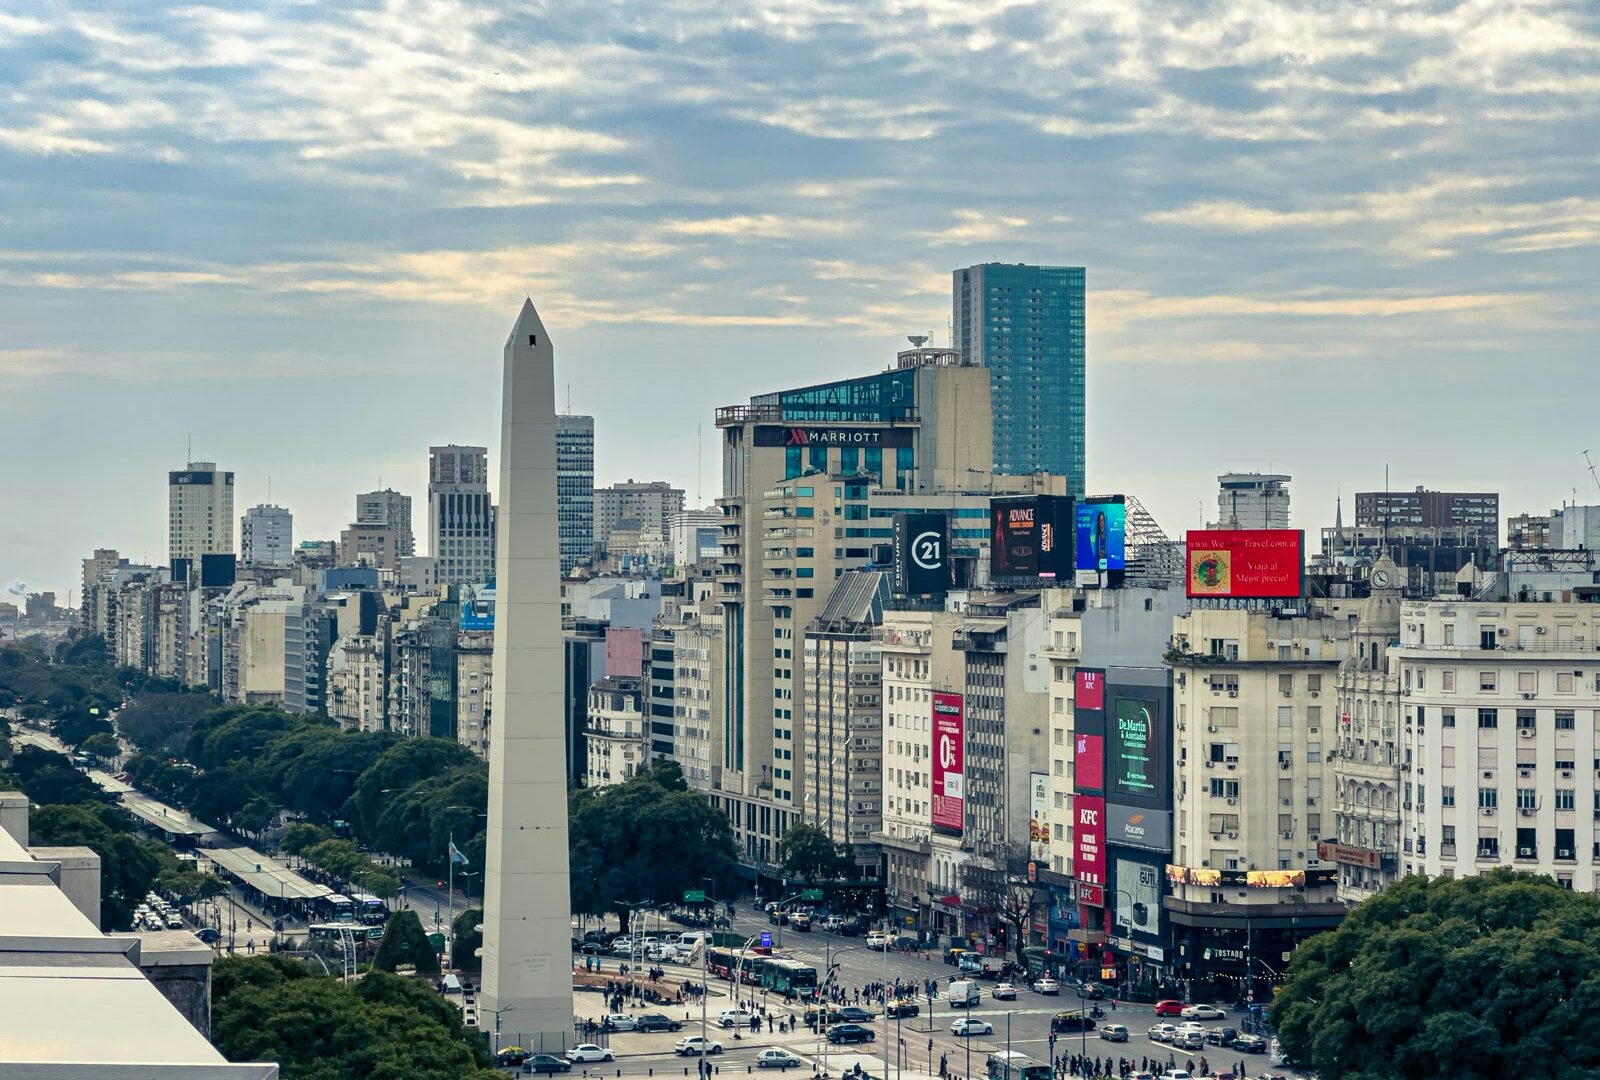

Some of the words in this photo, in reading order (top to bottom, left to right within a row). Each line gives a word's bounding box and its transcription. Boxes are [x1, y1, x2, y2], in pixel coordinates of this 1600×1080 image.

[809, 432, 880, 442] MARRIOTT
[1009, 508, 1034, 521] ADVANCE
[1247, 561, 1269, 571] Viaja
[1270, 561, 1278, 570] al
[1236, 573, 1259, 584] Mejor
[1261, 573, 1289, 584] precio!
[940, 734, 950, 769] 0
[1080, 808, 1098, 826] KFC
[1125, 824, 1144, 835] Atacama
[1081, 888, 1093, 900] KFC
[1214, 949, 1244, 960] TOSTADO
